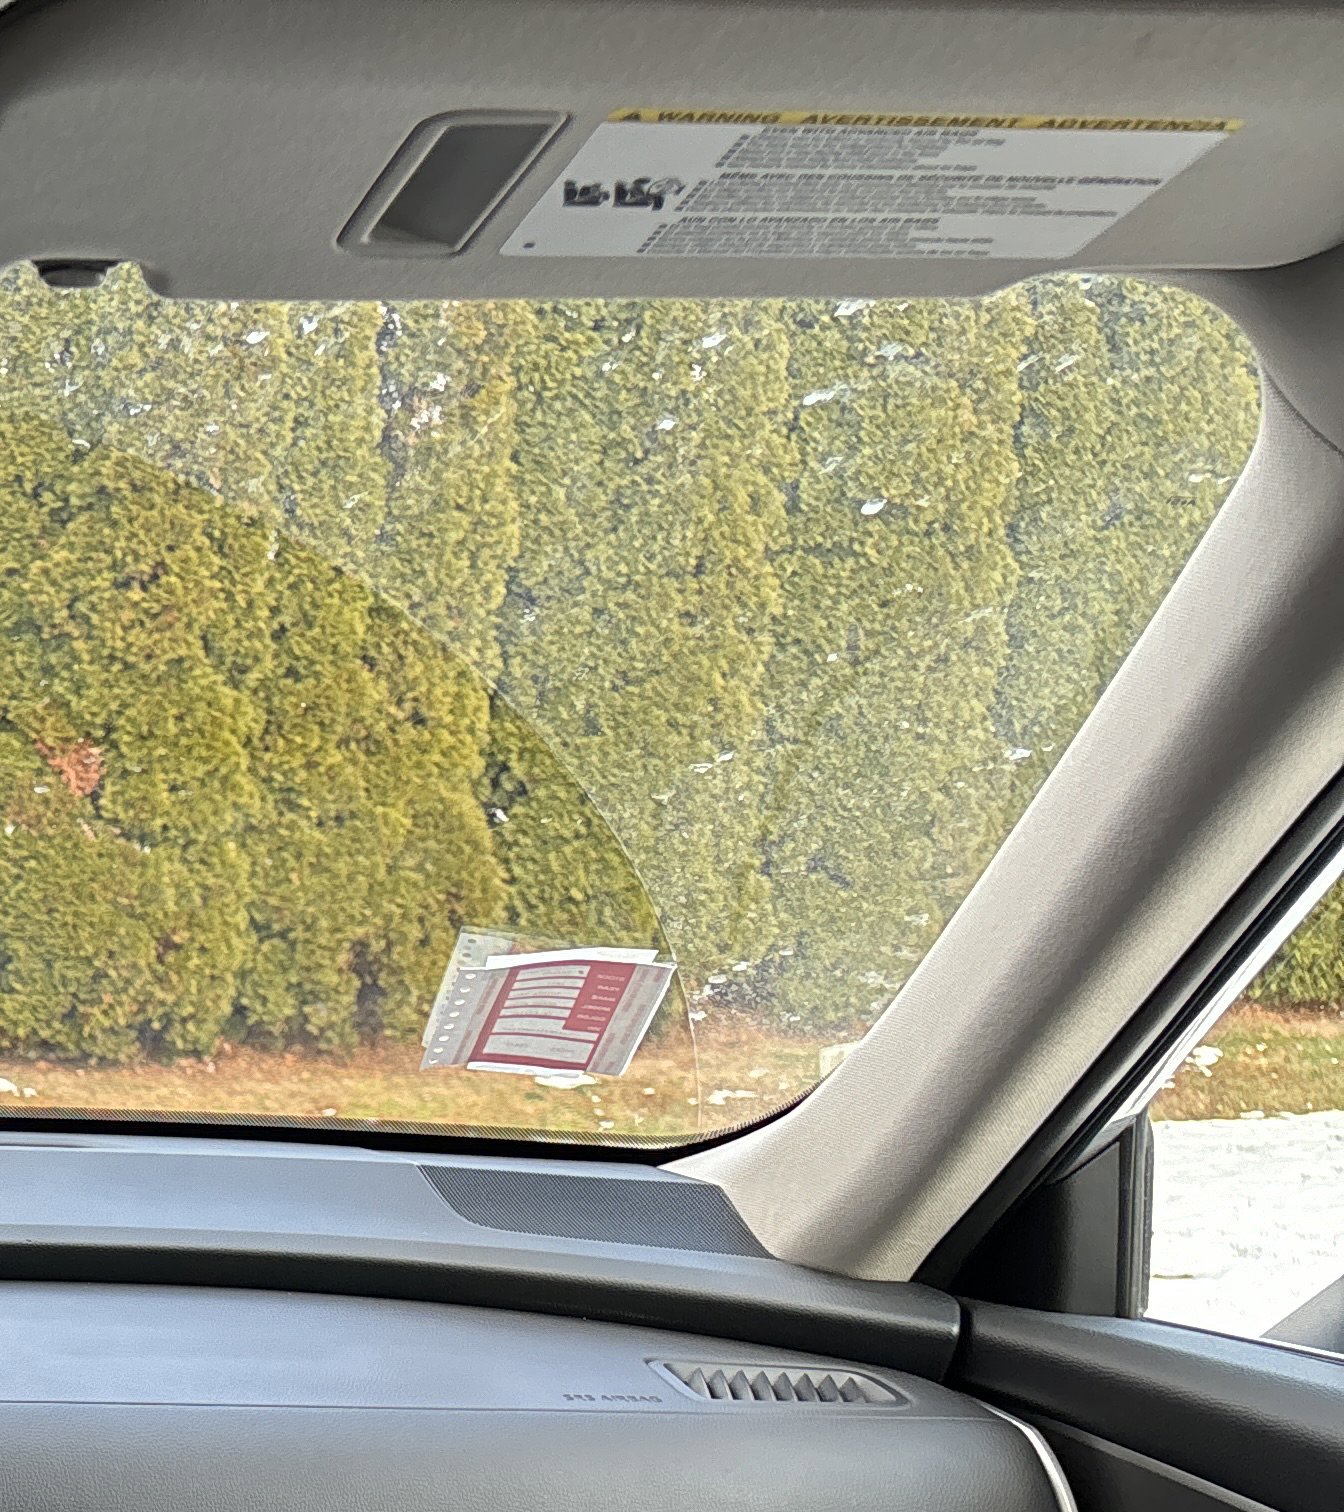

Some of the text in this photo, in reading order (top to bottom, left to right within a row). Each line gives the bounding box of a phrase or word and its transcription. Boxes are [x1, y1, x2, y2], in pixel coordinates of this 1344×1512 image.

[658, 111, 1227, 131] WARNING AVERTISSEMENT ADVERTENCIA
